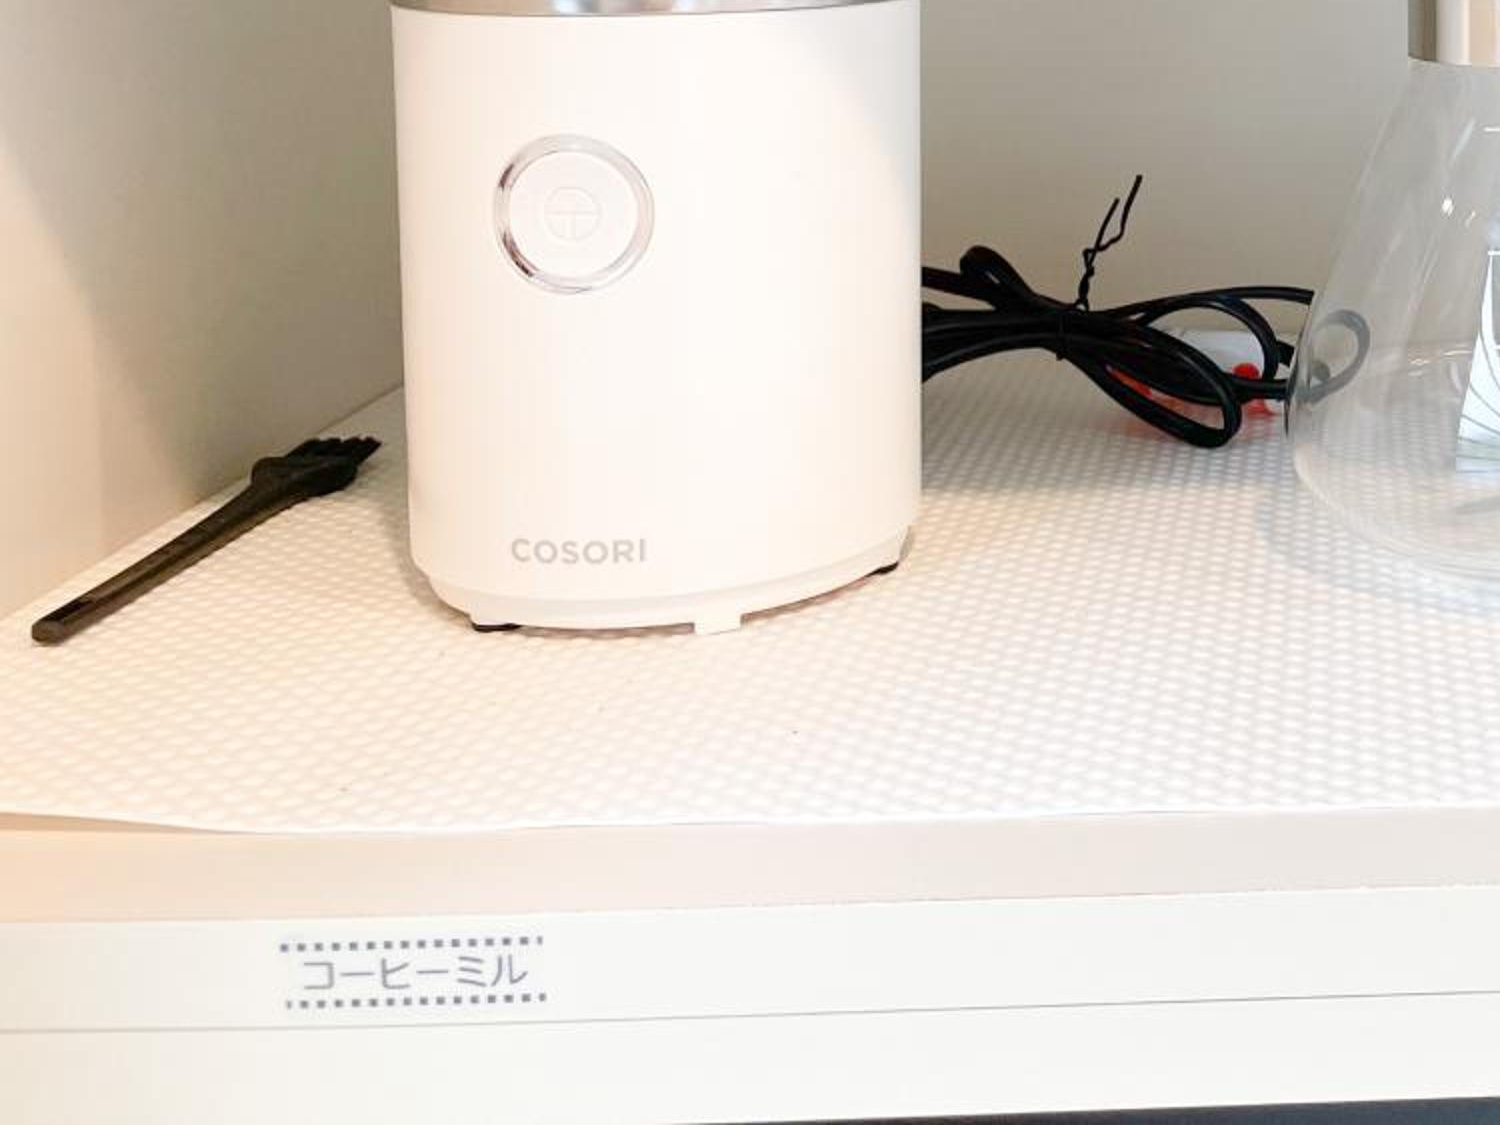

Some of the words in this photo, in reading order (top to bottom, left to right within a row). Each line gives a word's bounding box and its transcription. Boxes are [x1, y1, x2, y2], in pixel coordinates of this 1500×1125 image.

[511, 538, 649, 565] COSORI
[303, 954, 528, 990] コーヒーミル
